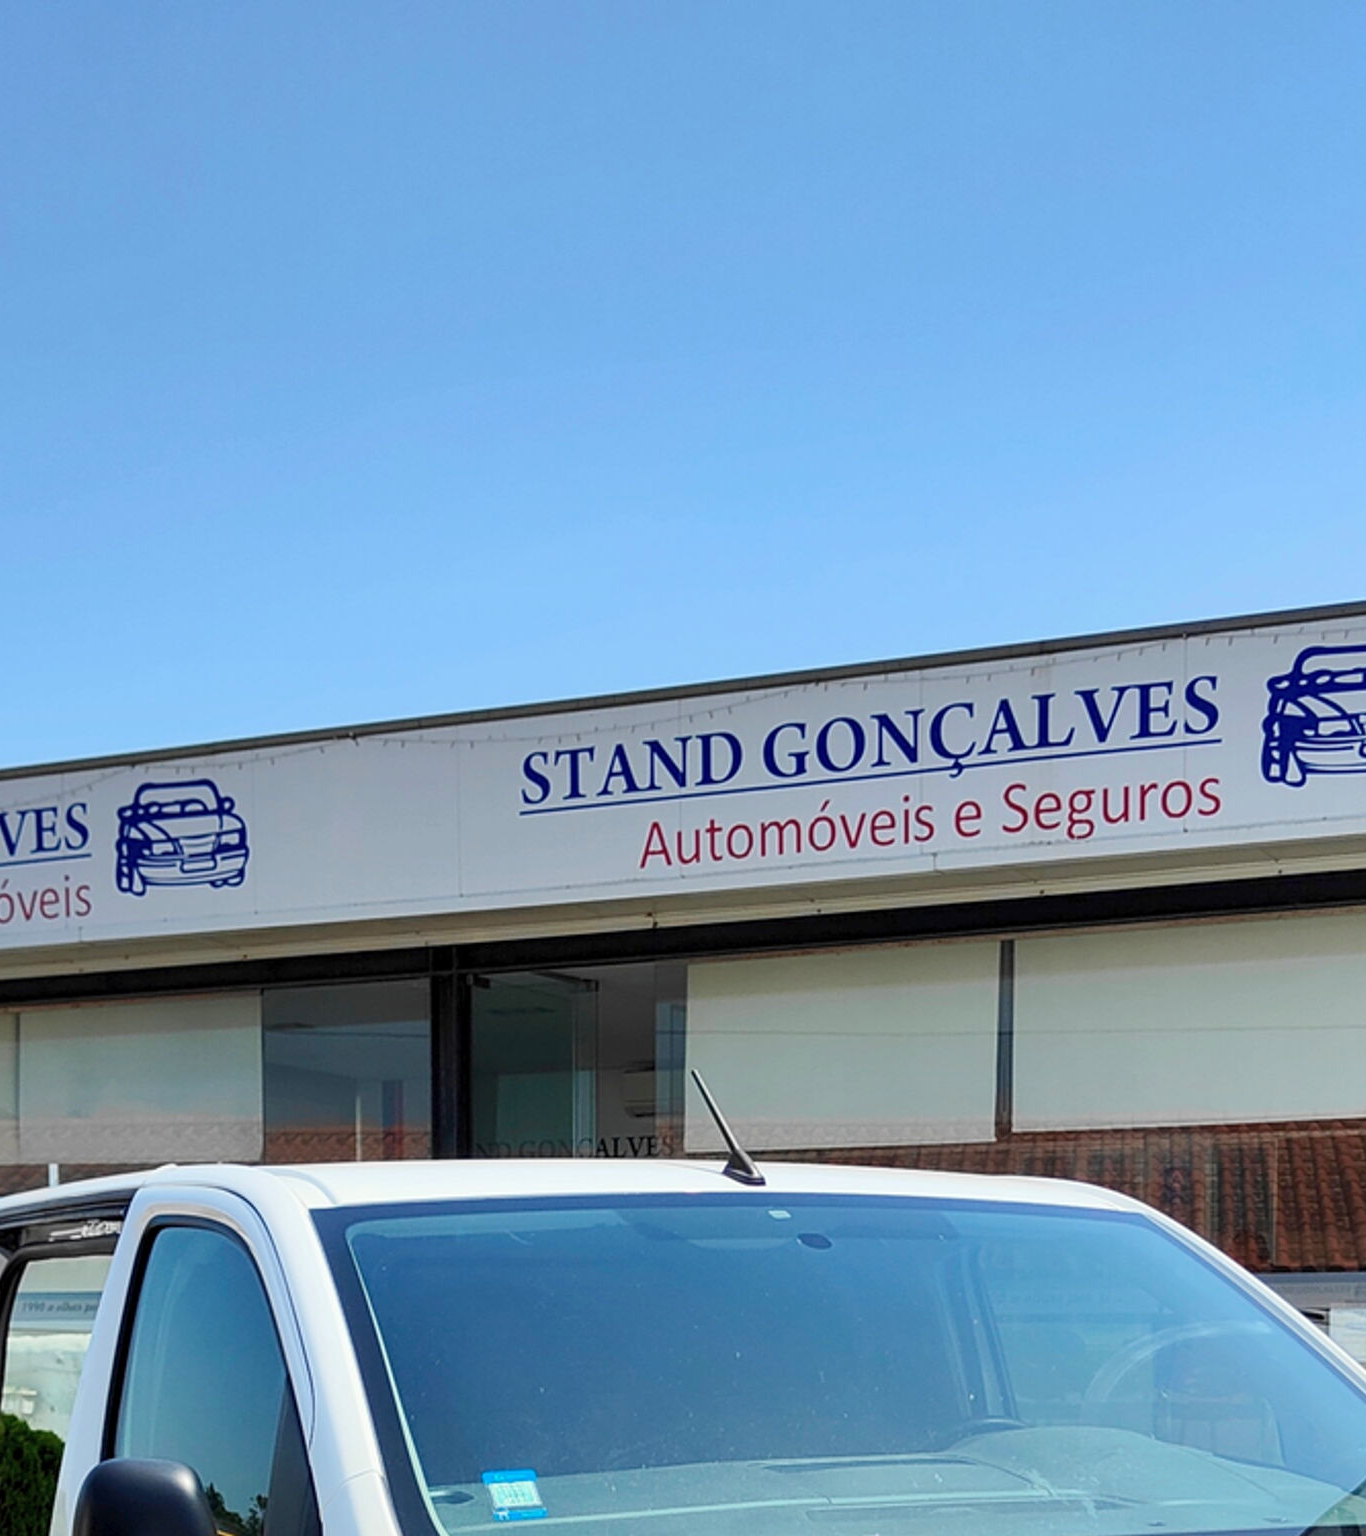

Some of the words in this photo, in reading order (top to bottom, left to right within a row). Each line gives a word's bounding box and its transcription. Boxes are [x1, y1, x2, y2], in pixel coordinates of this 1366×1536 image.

[520, 732, 743, 806] STAND
[763, 675, 1222, 779] GONÇALVES
[639, 796, 936, 869] Automóveis
[955, 800, 983, 838] e
[1002, 777, 1222, 842] Seguros
